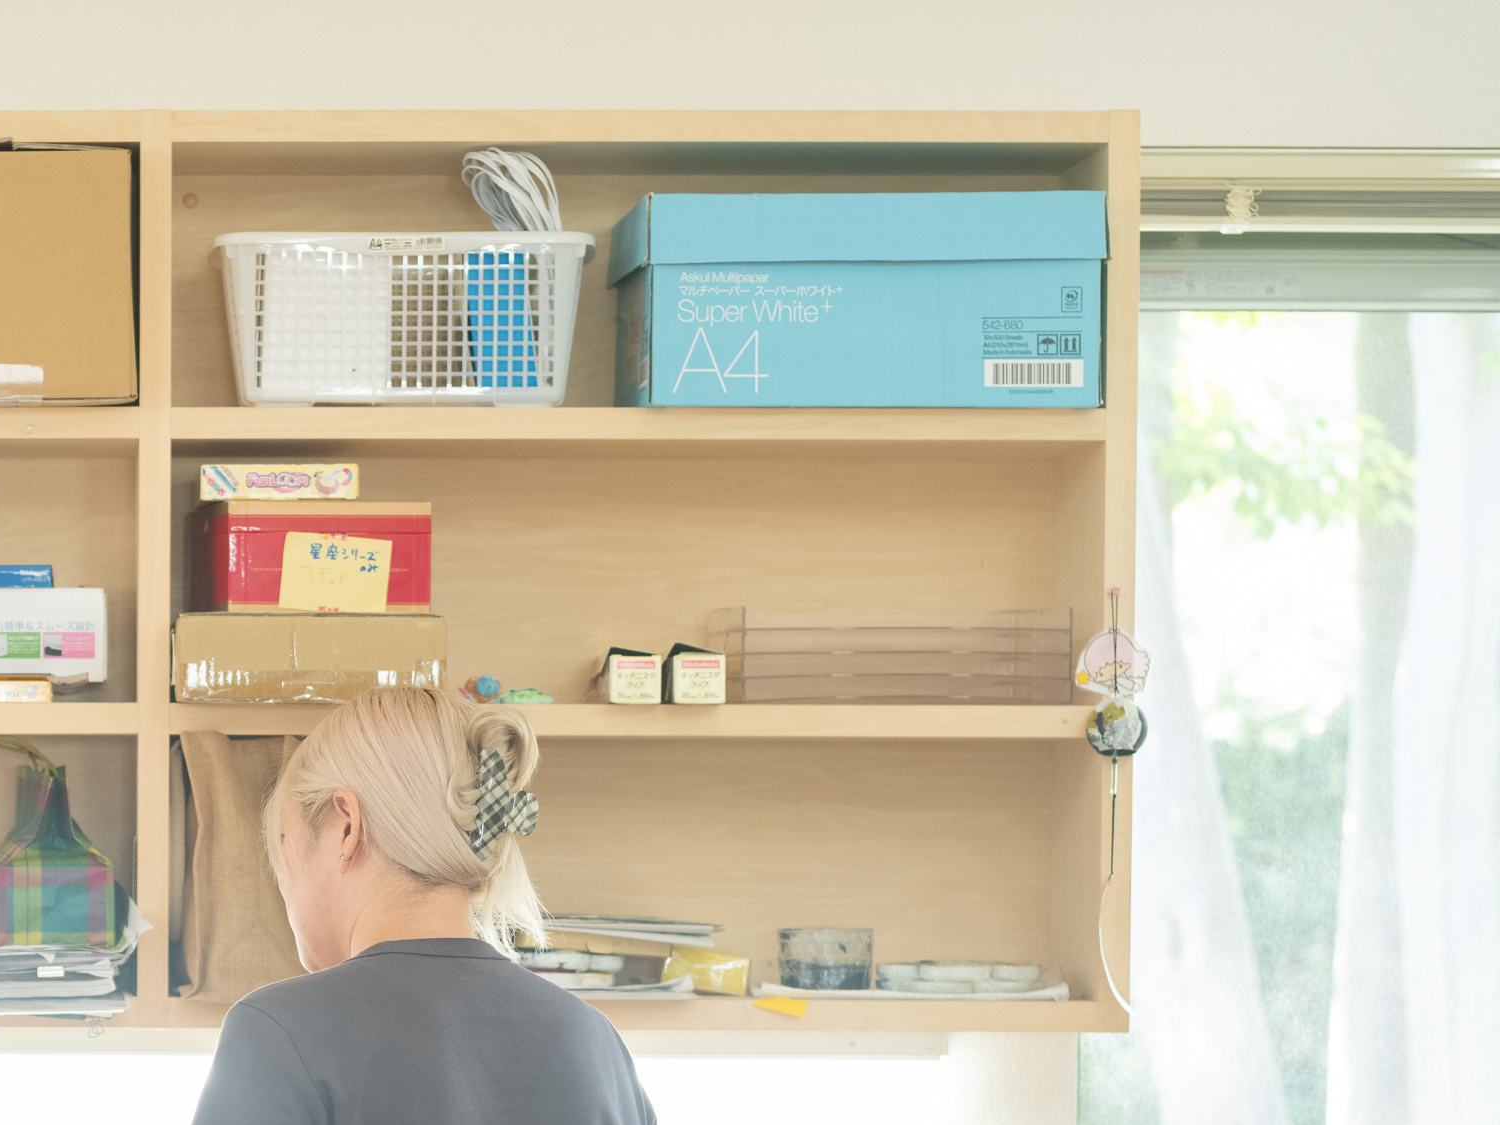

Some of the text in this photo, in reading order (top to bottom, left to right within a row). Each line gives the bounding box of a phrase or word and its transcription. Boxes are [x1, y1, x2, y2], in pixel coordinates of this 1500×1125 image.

[679, 271, 770, 285] Askul Multipaper
[678, 285, 751, 297] マルチペーパー
[677, 298, 749, 328] Super
[981, 319, 1024, 330] 542-680
[672, 326, 770, 394] A4
[310, 543, 381, 561] 星座シリーズ
[626, 681, 645, 689] ラップ
[690, 680, 709, 688] ラップ
